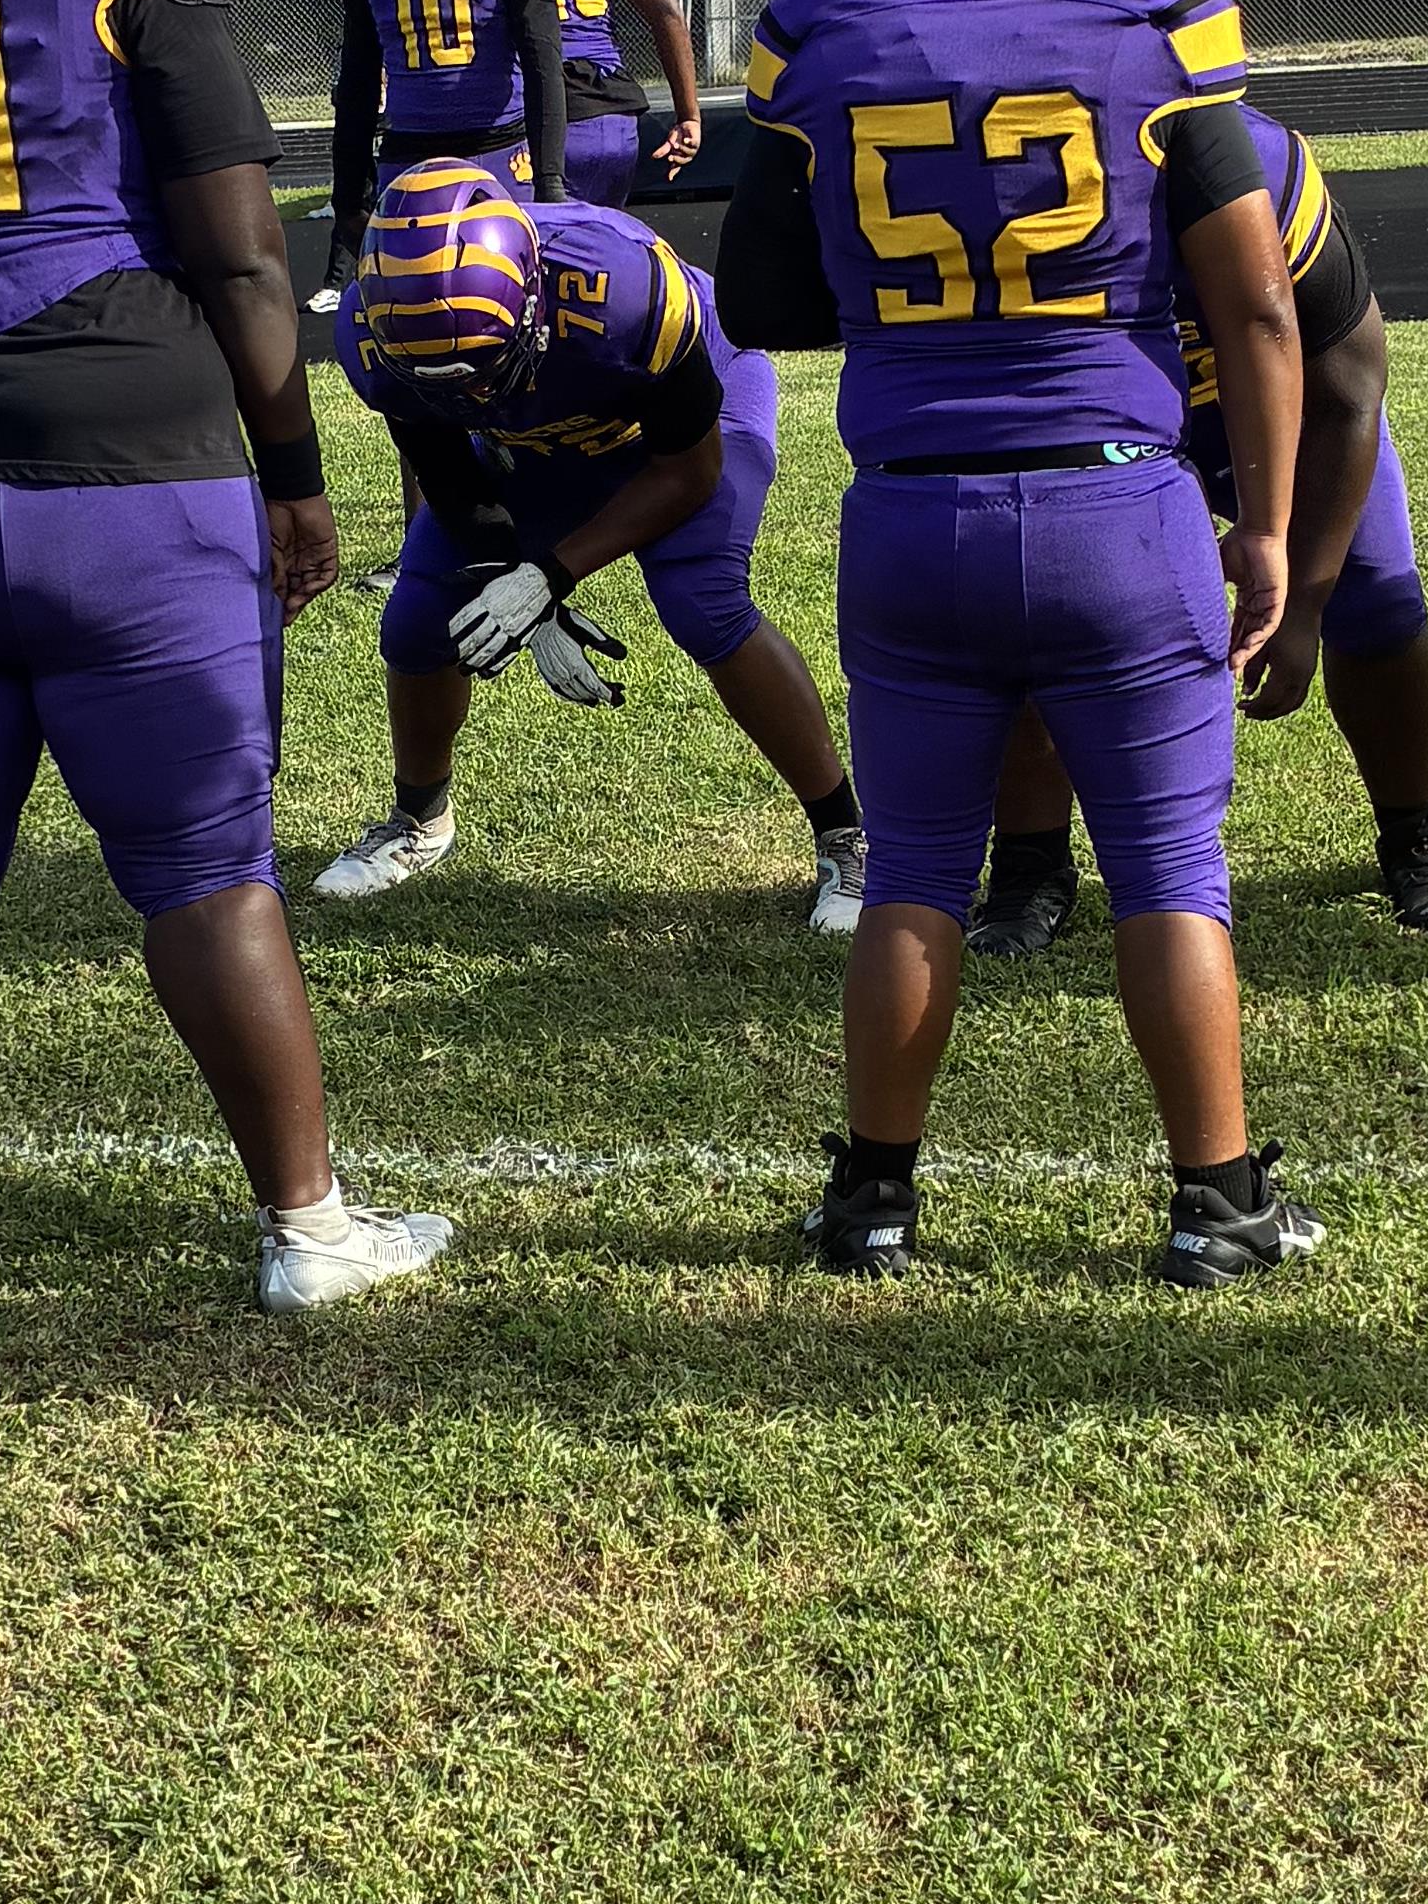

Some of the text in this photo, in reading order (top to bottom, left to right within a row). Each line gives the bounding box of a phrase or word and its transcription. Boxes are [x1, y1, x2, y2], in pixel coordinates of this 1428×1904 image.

[848, 91, 1107, 325] 52
[557, 270, 610, 338] 72
[865, 1226, 906, 1248] NIKE
[1170, 1231, 1211, 1254] NIKE
